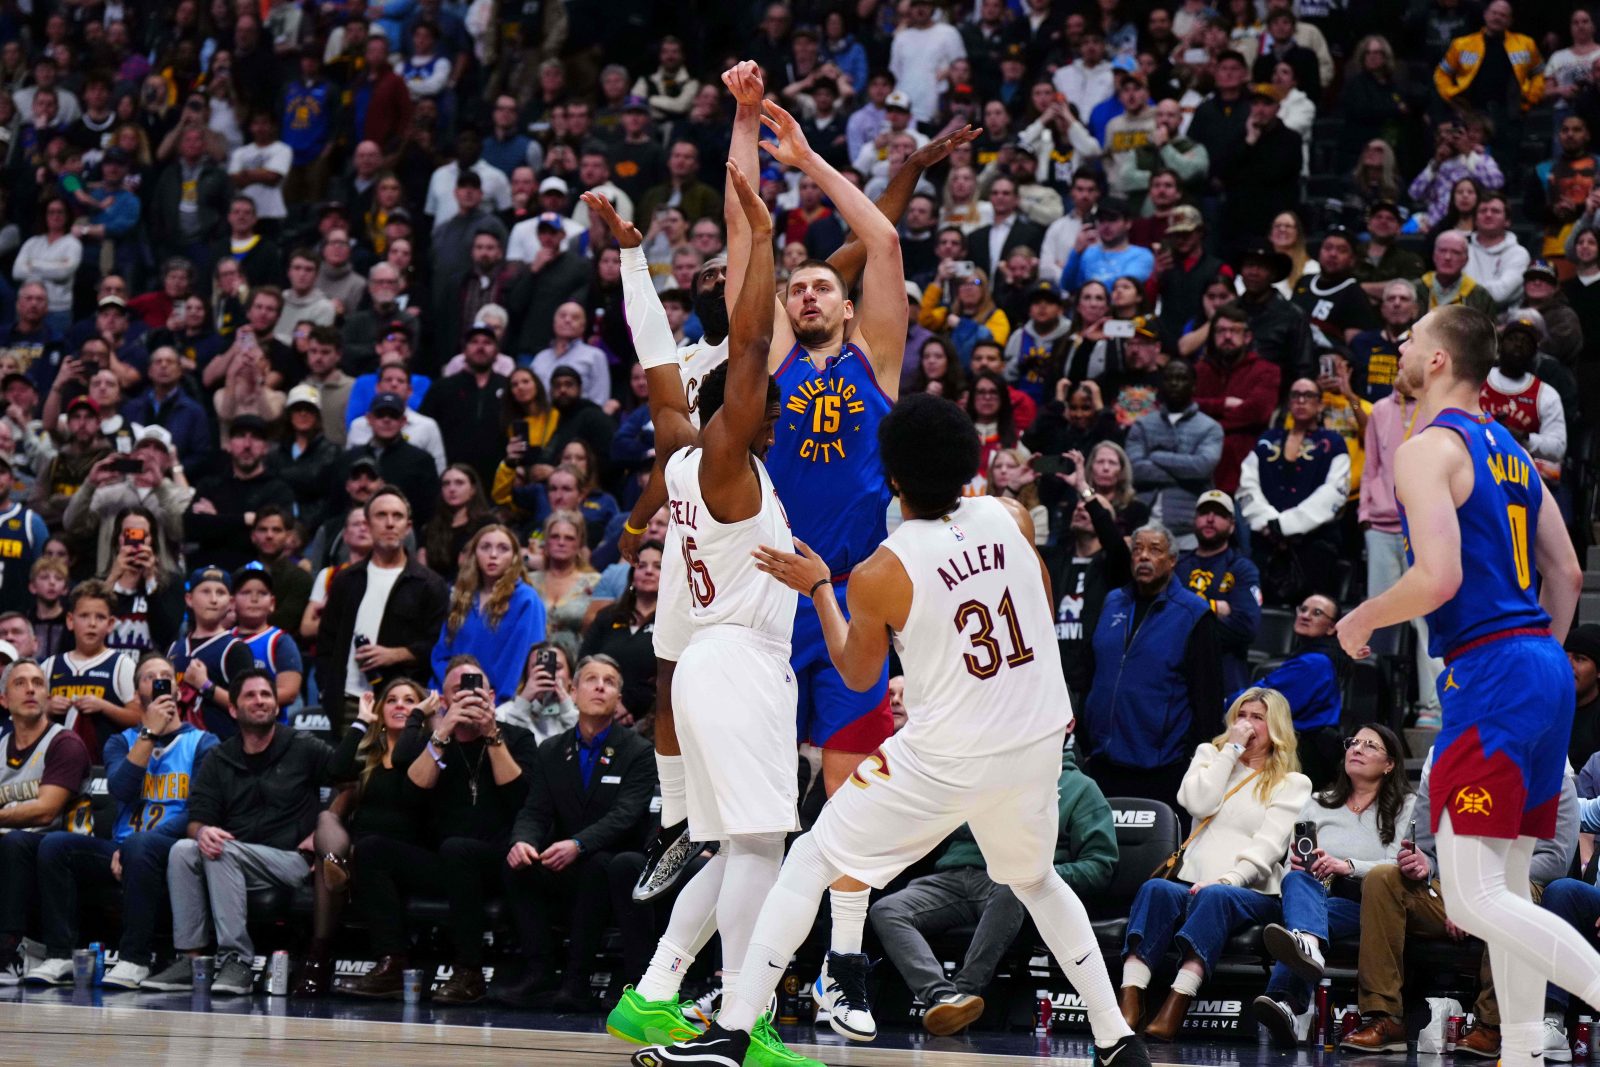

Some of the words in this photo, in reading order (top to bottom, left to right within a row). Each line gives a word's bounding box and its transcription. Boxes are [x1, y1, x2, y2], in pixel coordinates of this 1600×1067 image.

[786, 378, 828, 415] MILE
[812, 395, 841, 434] 15
[799, 438, 846, 464] CITY
[669, 499, 698, 531] ELL
[1507, 503, 1531, 591] 0
[936, 543, 1006, 592] ALLEN
[132, 596, 149, 614] 15
[953, 585, 1035, 681] 31
[294, 714, 332, 731] UM
[14, 778, 42, 801] LAN
[143, 772, 190, 800] NVER
[128, 803, 165, 833] 42
[1113, 810, 1156, 828] MB
[434, 965, 494, 983] UB
[1047, 992, 1088, 1009] UM
[1051, 1012, 1085, 1022] ESER
[1183, 1019, 1238, 1029] ESERVE
